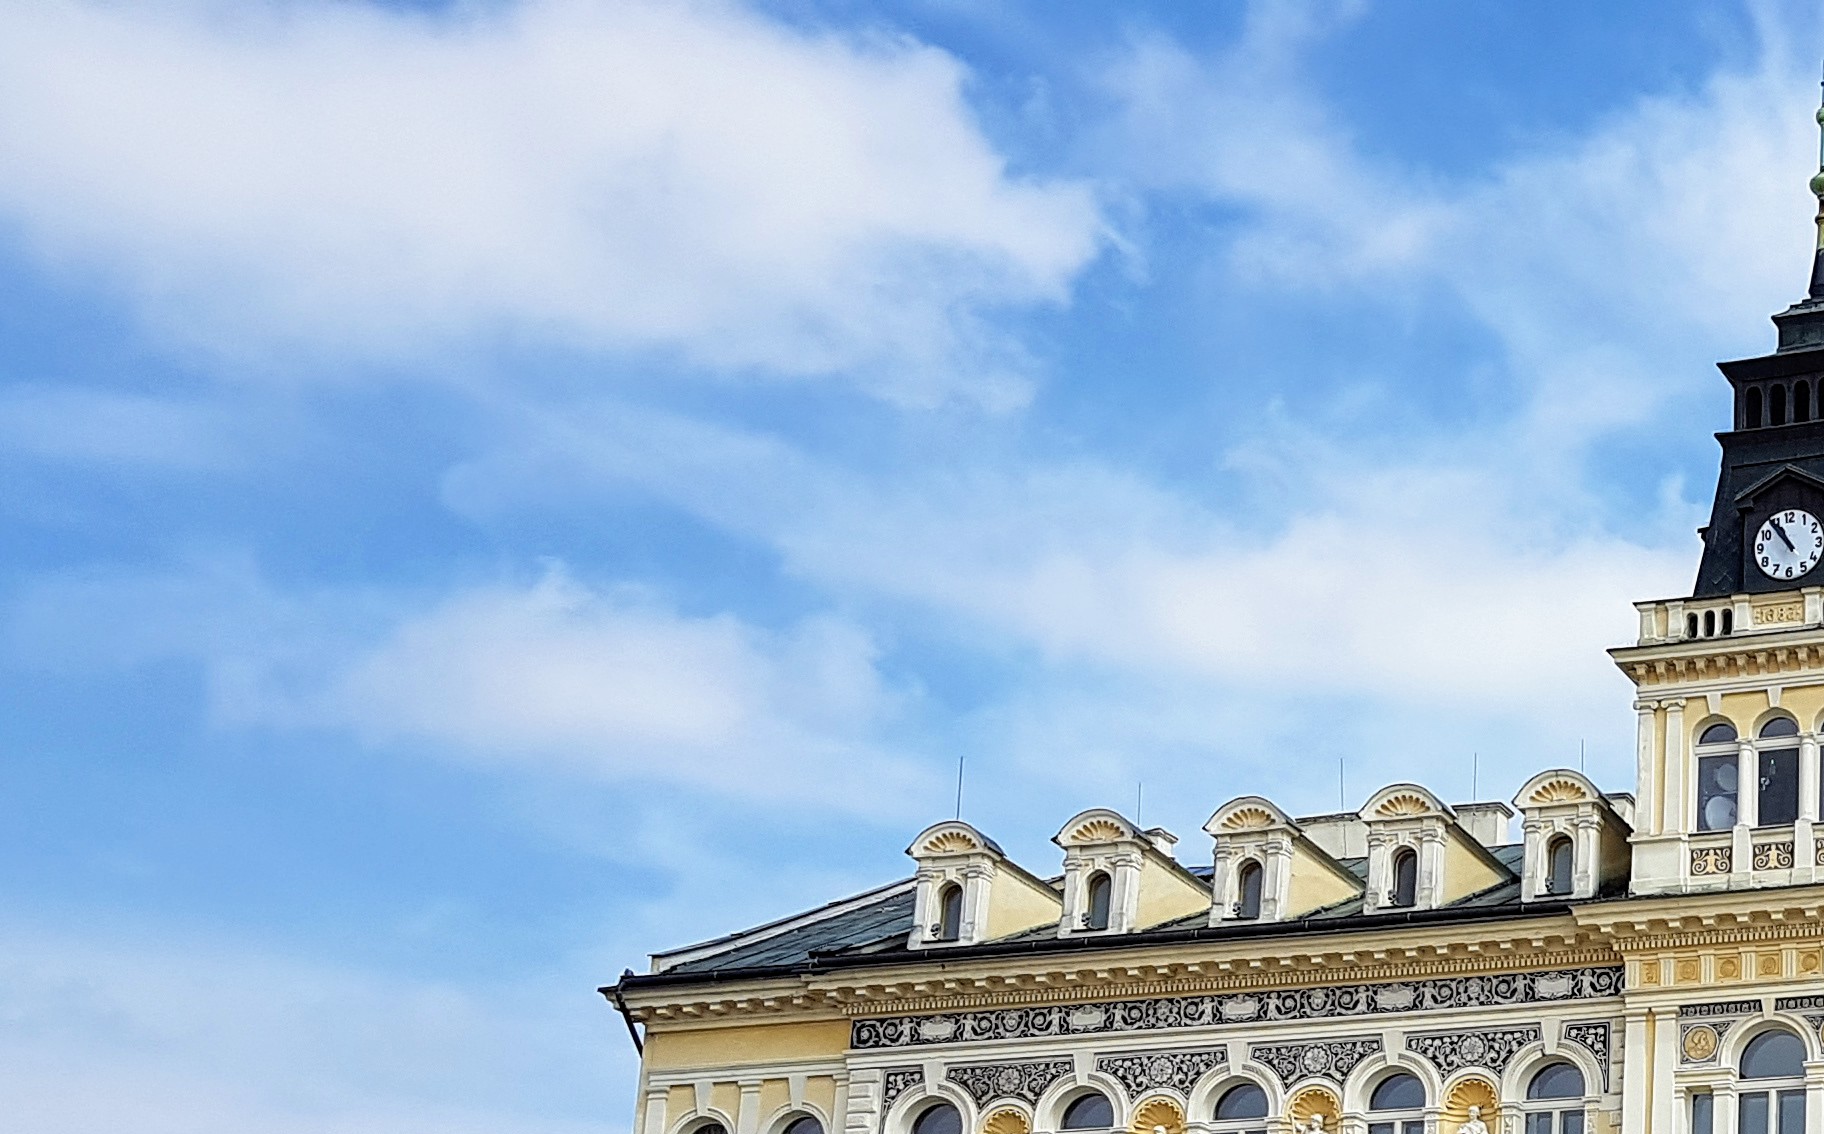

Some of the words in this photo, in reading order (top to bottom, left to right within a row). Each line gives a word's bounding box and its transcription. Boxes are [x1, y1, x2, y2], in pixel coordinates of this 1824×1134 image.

[1784, 511, 1795, 523] 12
[1801, 513, 1806, 525] 1
[1811, 522, 1818, 533] 2
[1761, 530, 1772, 541] 10
[1815, 536, 1822, 548] 3
[1756, 543, 1764, 554] 9
[1761, 556, 1769, 567] 8
[1809, 551, 1817, 562] 4
[1772, 563, 1780, 575] 7
[1799, 561, 1807, 572] 5
[1785, 567, 1793, 578] 6
